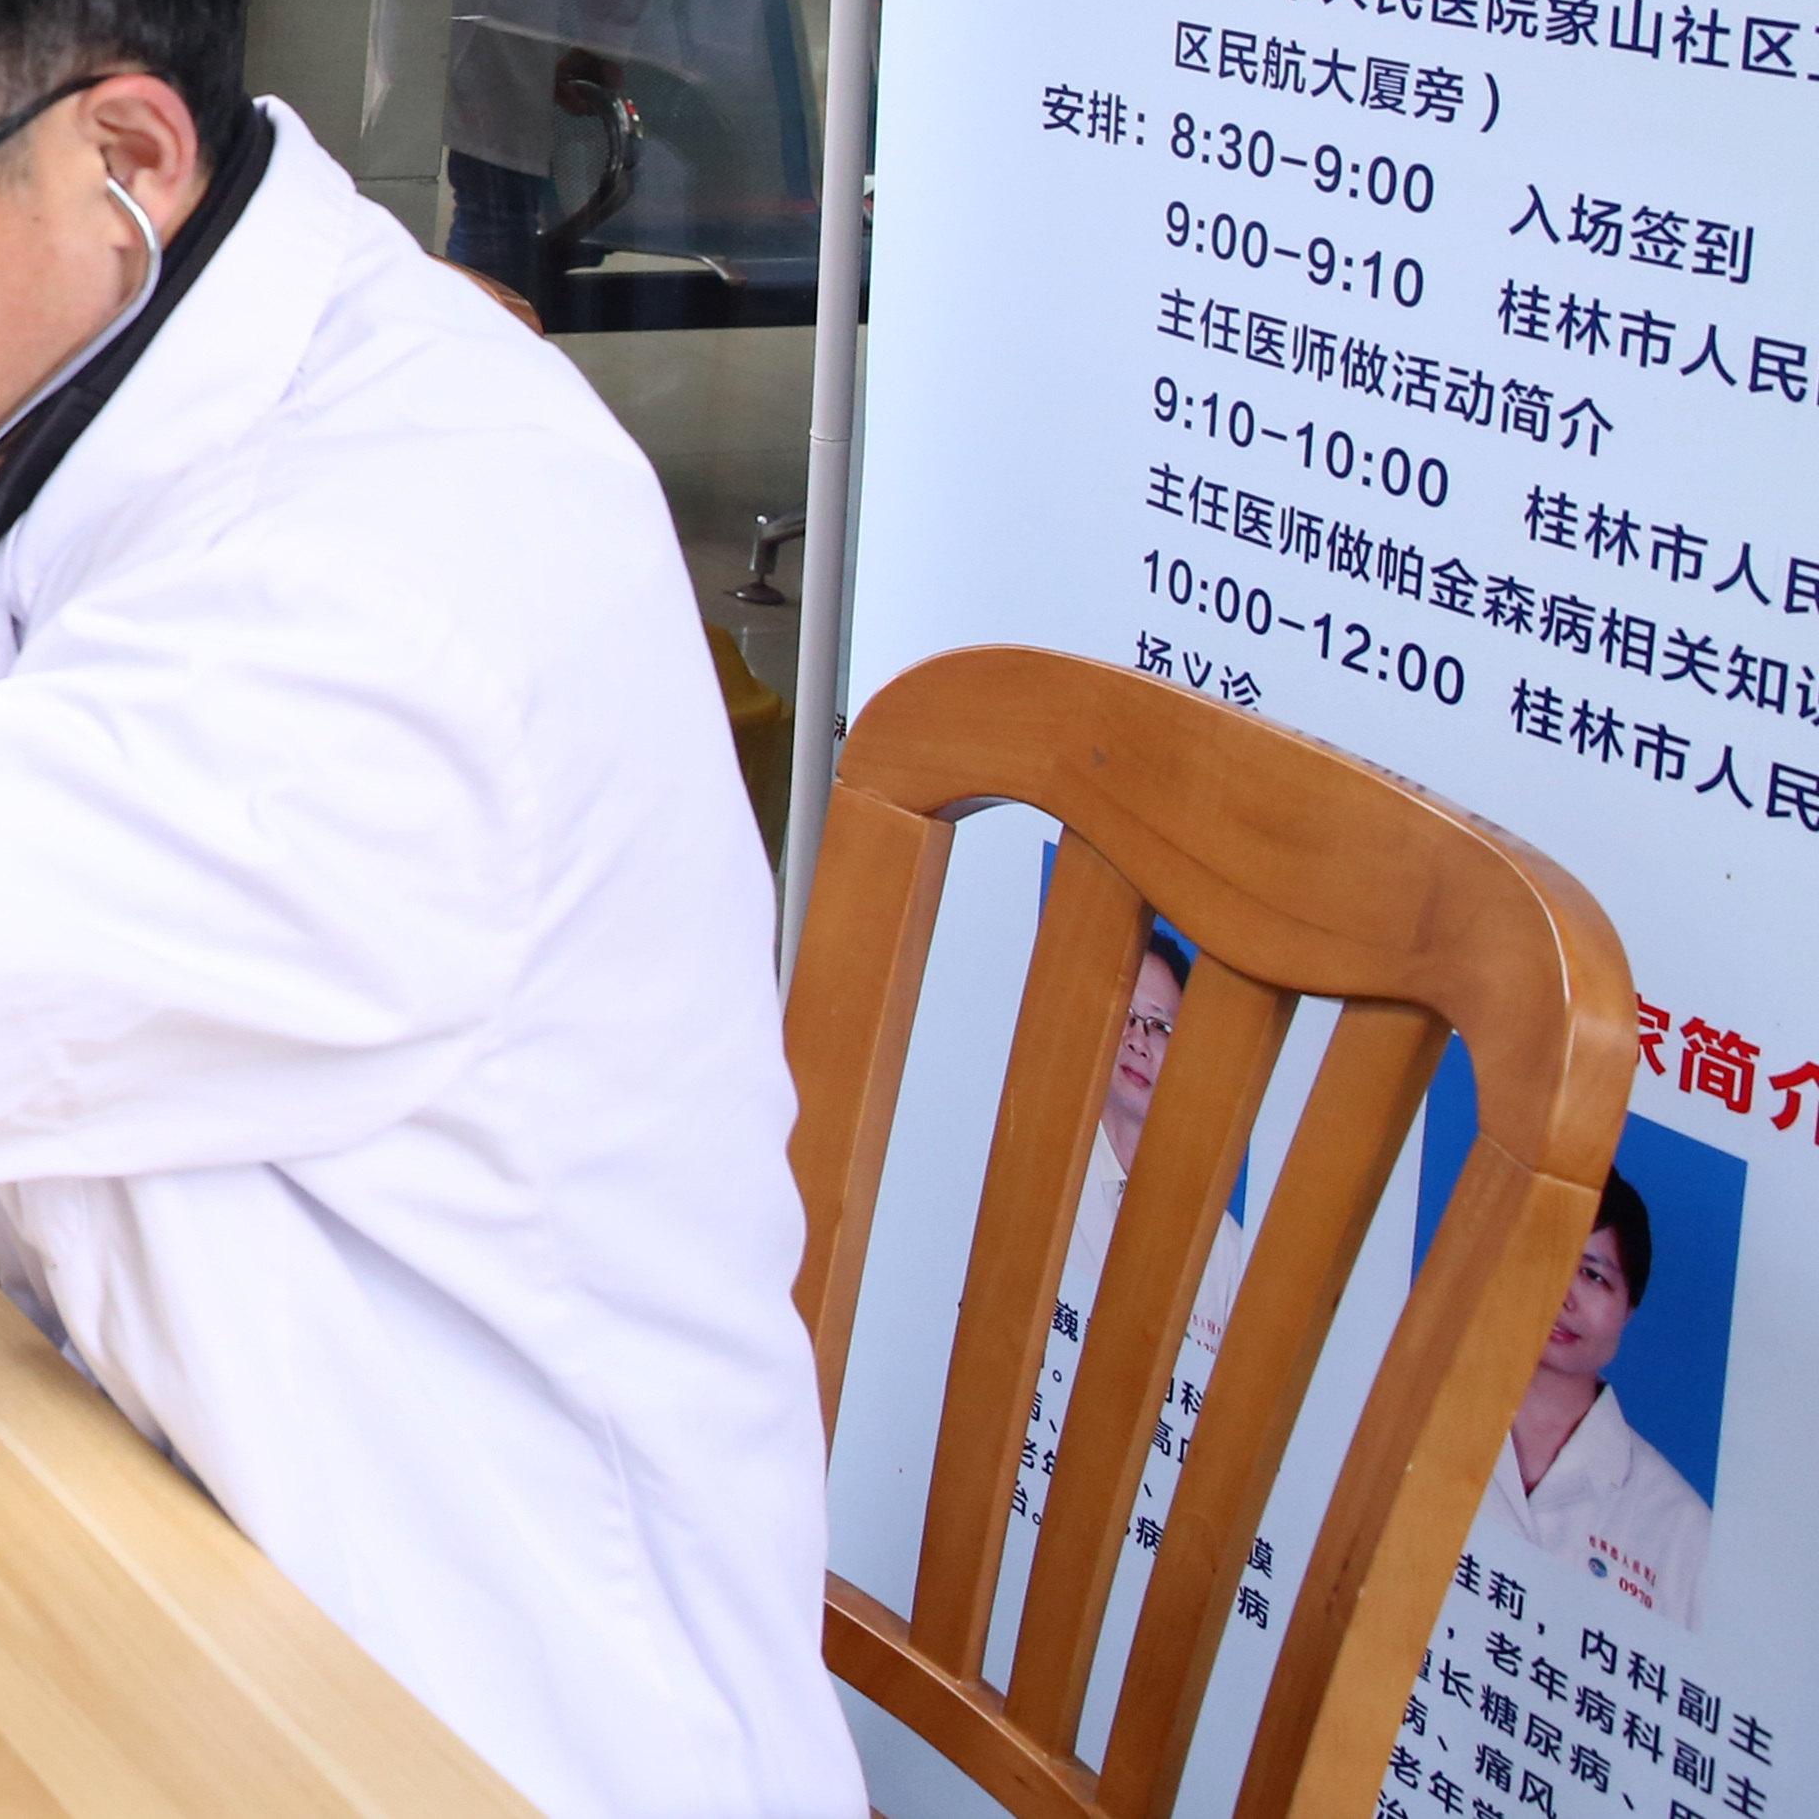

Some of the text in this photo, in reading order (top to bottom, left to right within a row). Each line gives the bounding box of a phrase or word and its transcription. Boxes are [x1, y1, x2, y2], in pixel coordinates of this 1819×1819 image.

[1173, 19, 1502, 134] 区民航大厦旁）
[1508, 182, 1755, 286] 入场签到
[1156, 287, 1614, 457] 主任医师做活动简介
[1498, 278, 1819, 404] 桂林市人民
[1510, 678, 1819, 832] 桂林市人民
